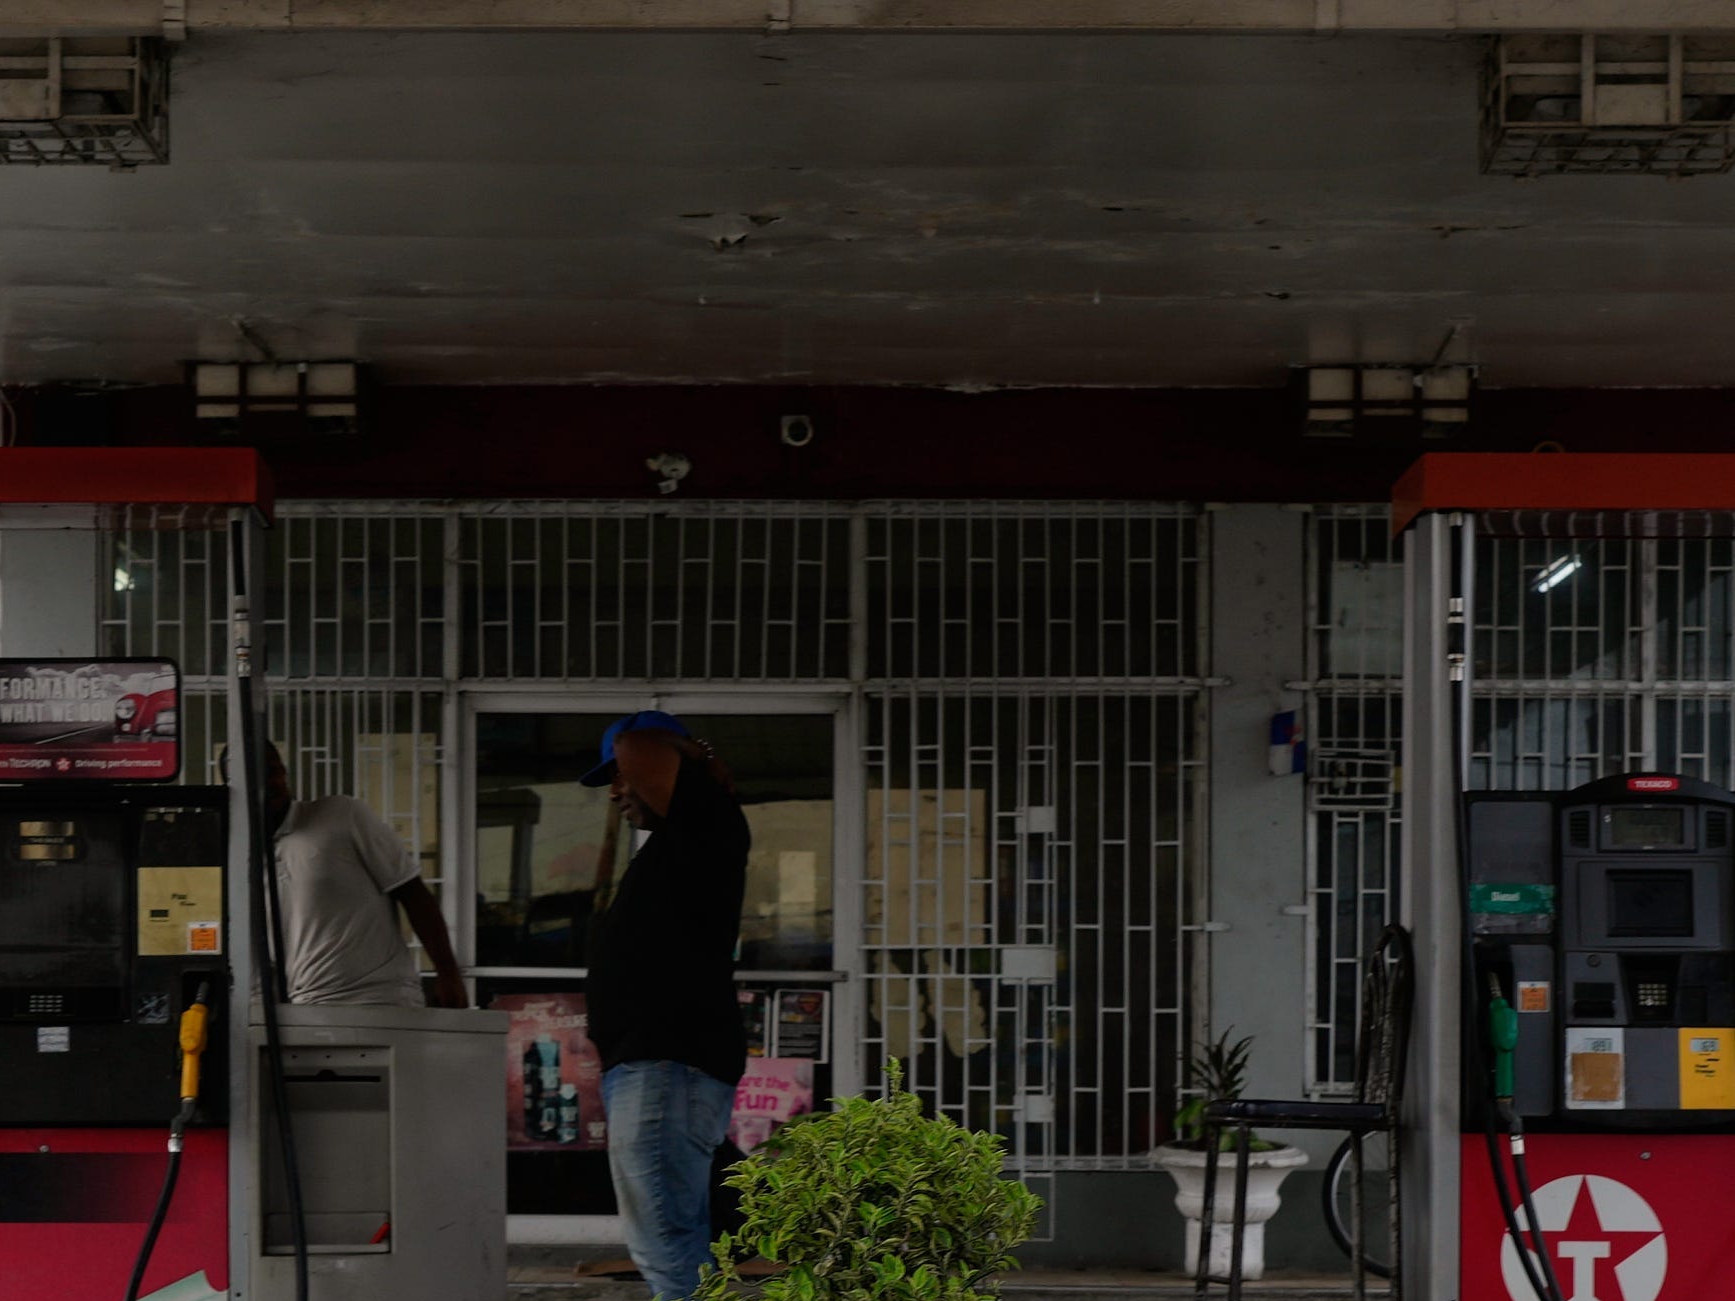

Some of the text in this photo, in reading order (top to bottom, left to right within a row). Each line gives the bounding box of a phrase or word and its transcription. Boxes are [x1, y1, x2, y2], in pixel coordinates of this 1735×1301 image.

[48, 703, 75, 722] WE
[75, 759, 163, 770] Driving performance
[765, 1075, 791, 1091] the
[733, 1089, 779, 1111] Fun
